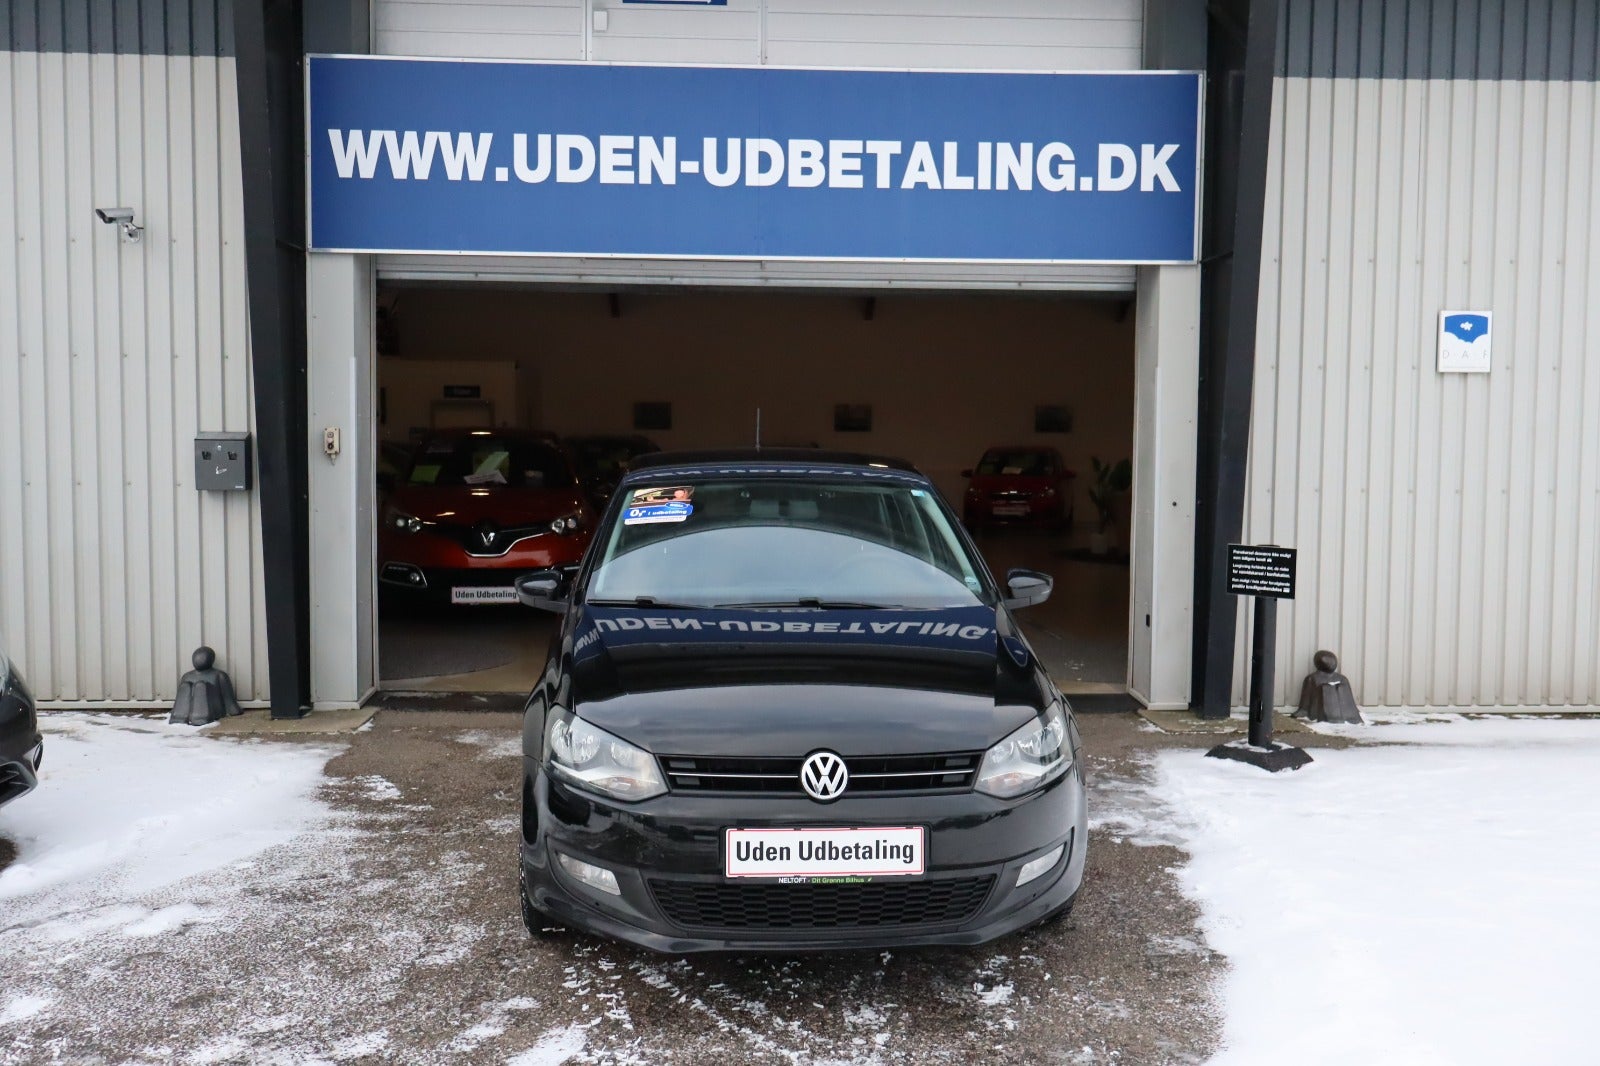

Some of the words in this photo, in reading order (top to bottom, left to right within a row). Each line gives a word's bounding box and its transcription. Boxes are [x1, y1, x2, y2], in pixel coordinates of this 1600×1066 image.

[328, 129, 1181, 192] WWW.UDEN-UDBETALING.DK
[477, 591, 517, 599] Udbetaling
[736, 841, 790, 861] Uden
[799, 840, 914, 864] Udbetaling
